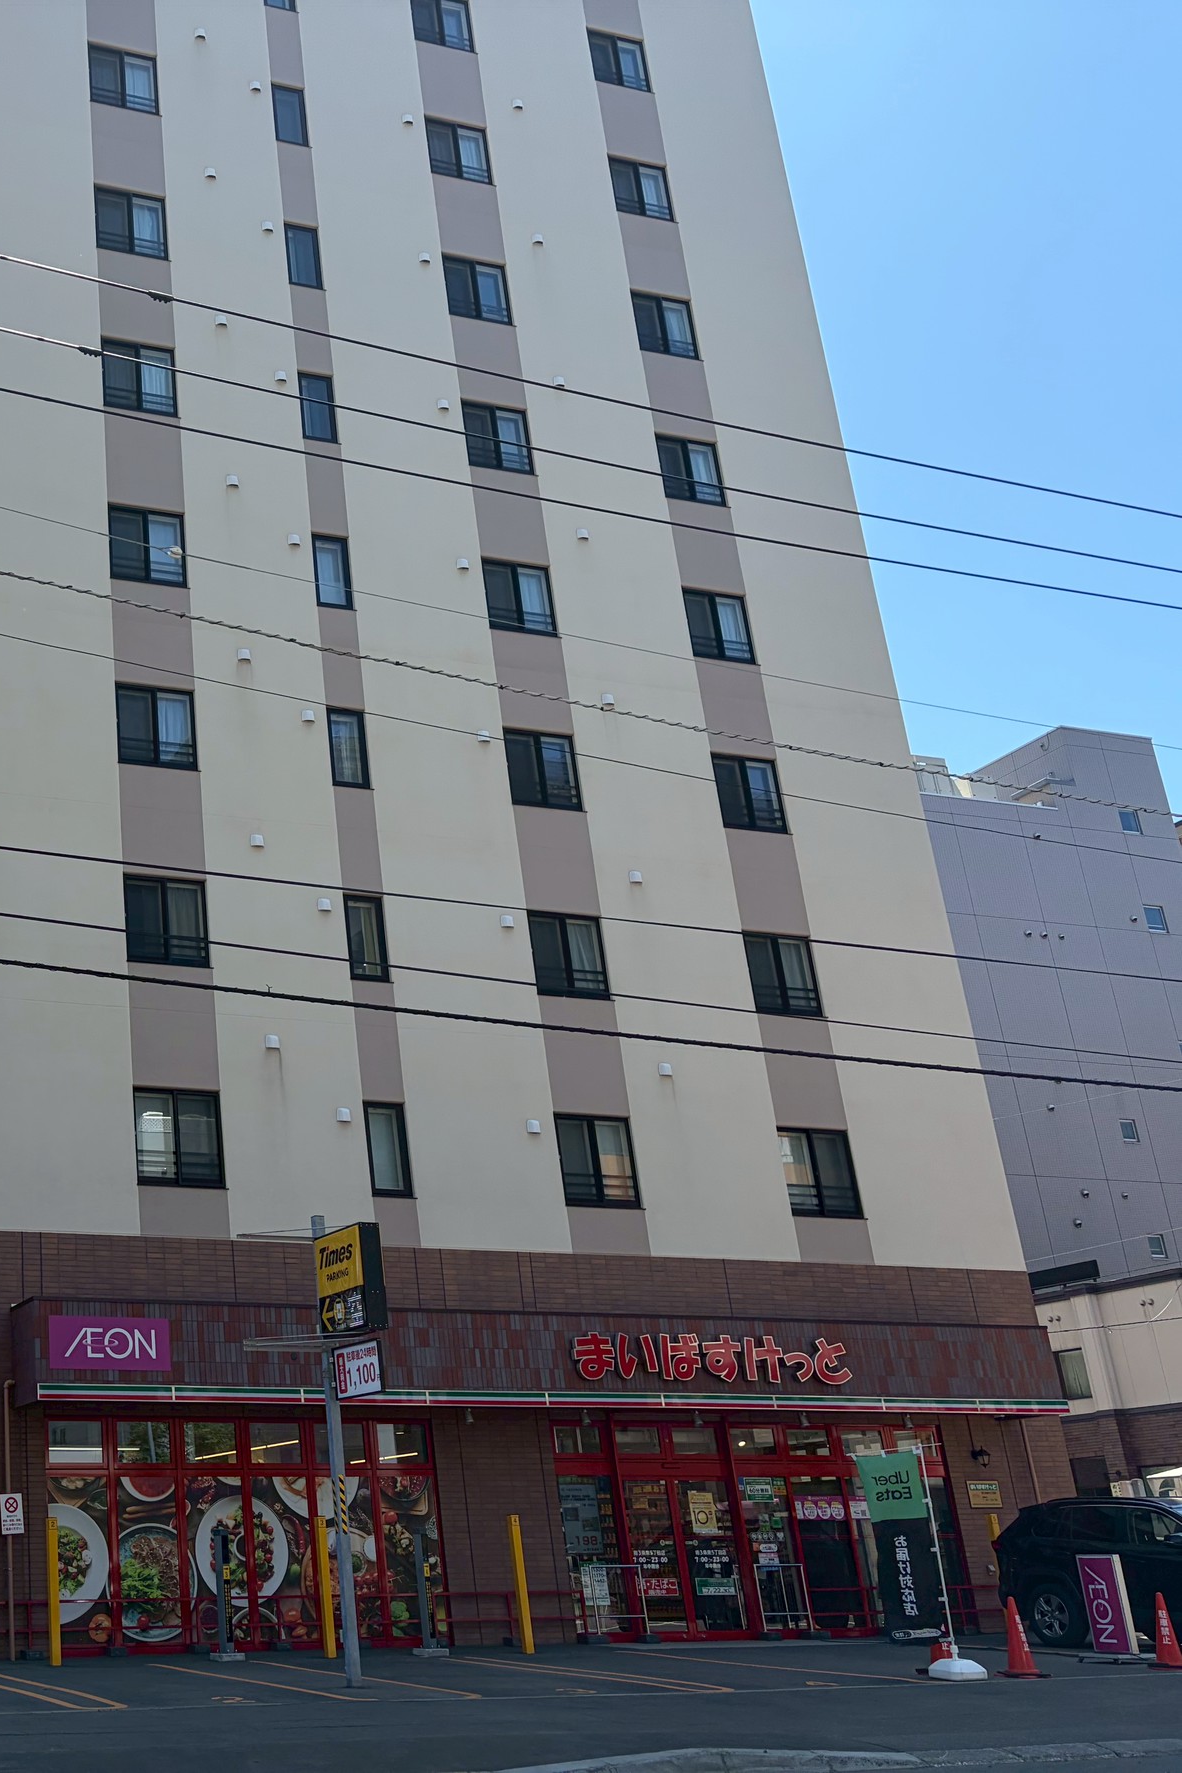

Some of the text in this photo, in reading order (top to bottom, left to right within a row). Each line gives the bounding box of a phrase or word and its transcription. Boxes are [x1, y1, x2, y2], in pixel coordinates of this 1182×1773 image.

[319, 1243, 353, 1270] Times
[326, 1268, 349, 1283] PARKING
[64, 1327, 156, 1360] AEON
[573, 1331, 854, 1386] まいばすけっと
[1084, 1565, 1118, 1644] AEON
[1158, 1610, 1172, 1645] 駐車禁止
